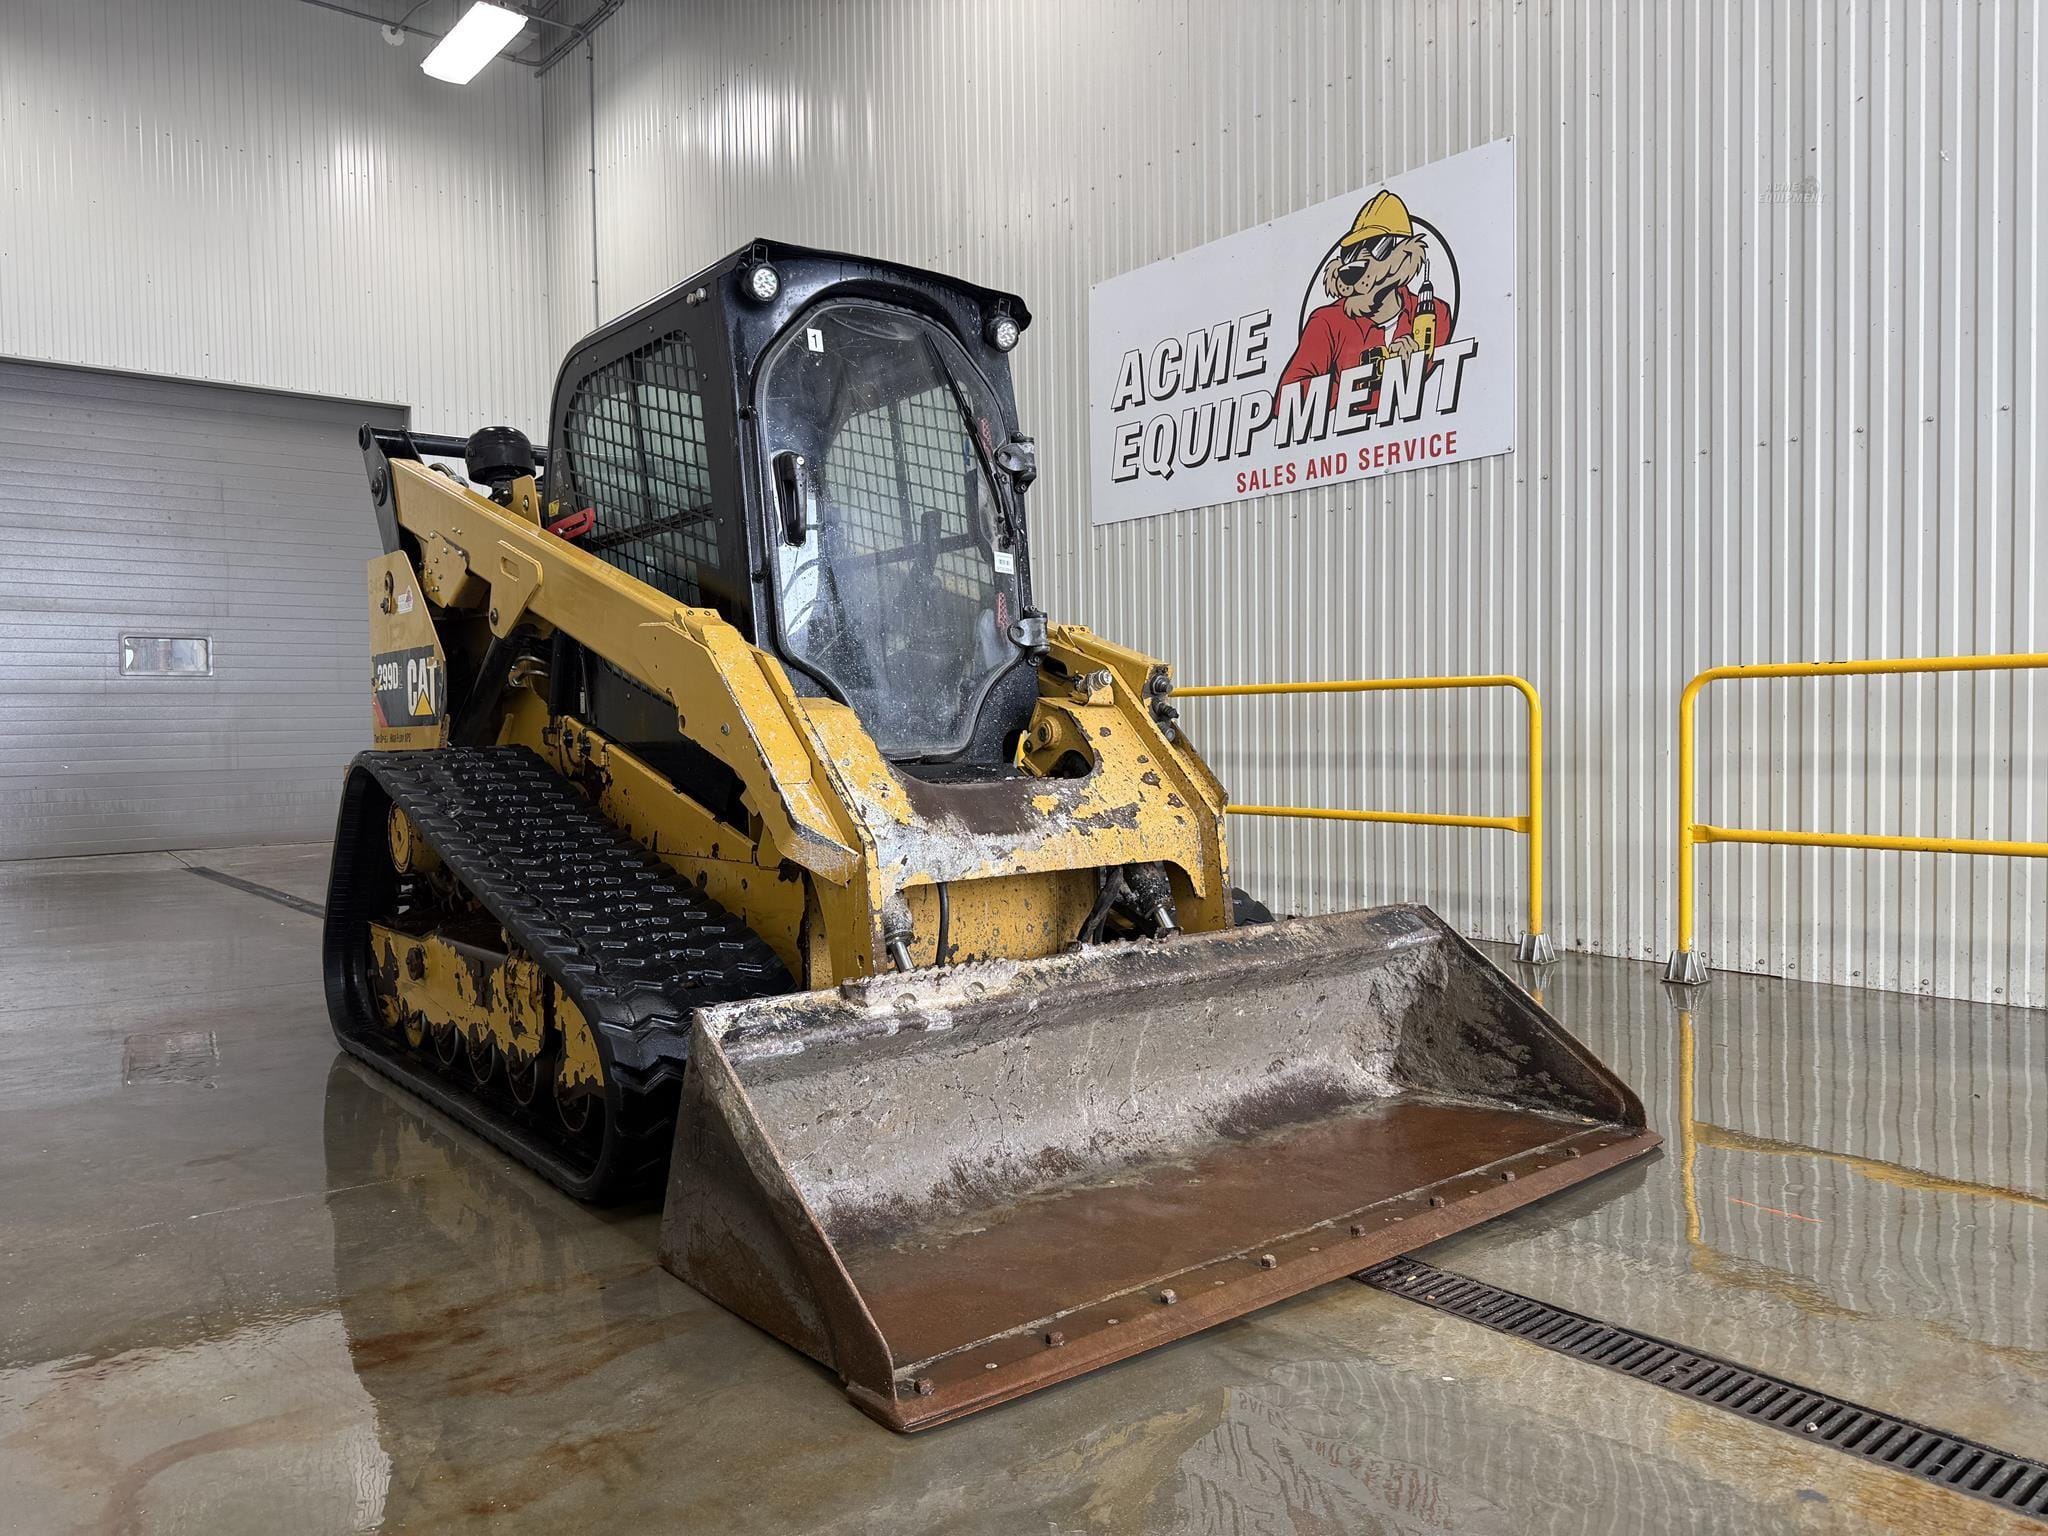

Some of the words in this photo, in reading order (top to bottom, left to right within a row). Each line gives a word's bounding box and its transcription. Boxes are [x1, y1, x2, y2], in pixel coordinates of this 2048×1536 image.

[1111, 309, 1272, 412] ACME
[1112, 337, 1479, 483] EQUIPMENT
[1236, 462, 1297, 494] SALES
[1306, 452, 1348, 481] AND
[1358, 430, 1457, 471] SERVICE
[377, 661, 399, 691] 299D
[407, 657, 437, 717] CAT
